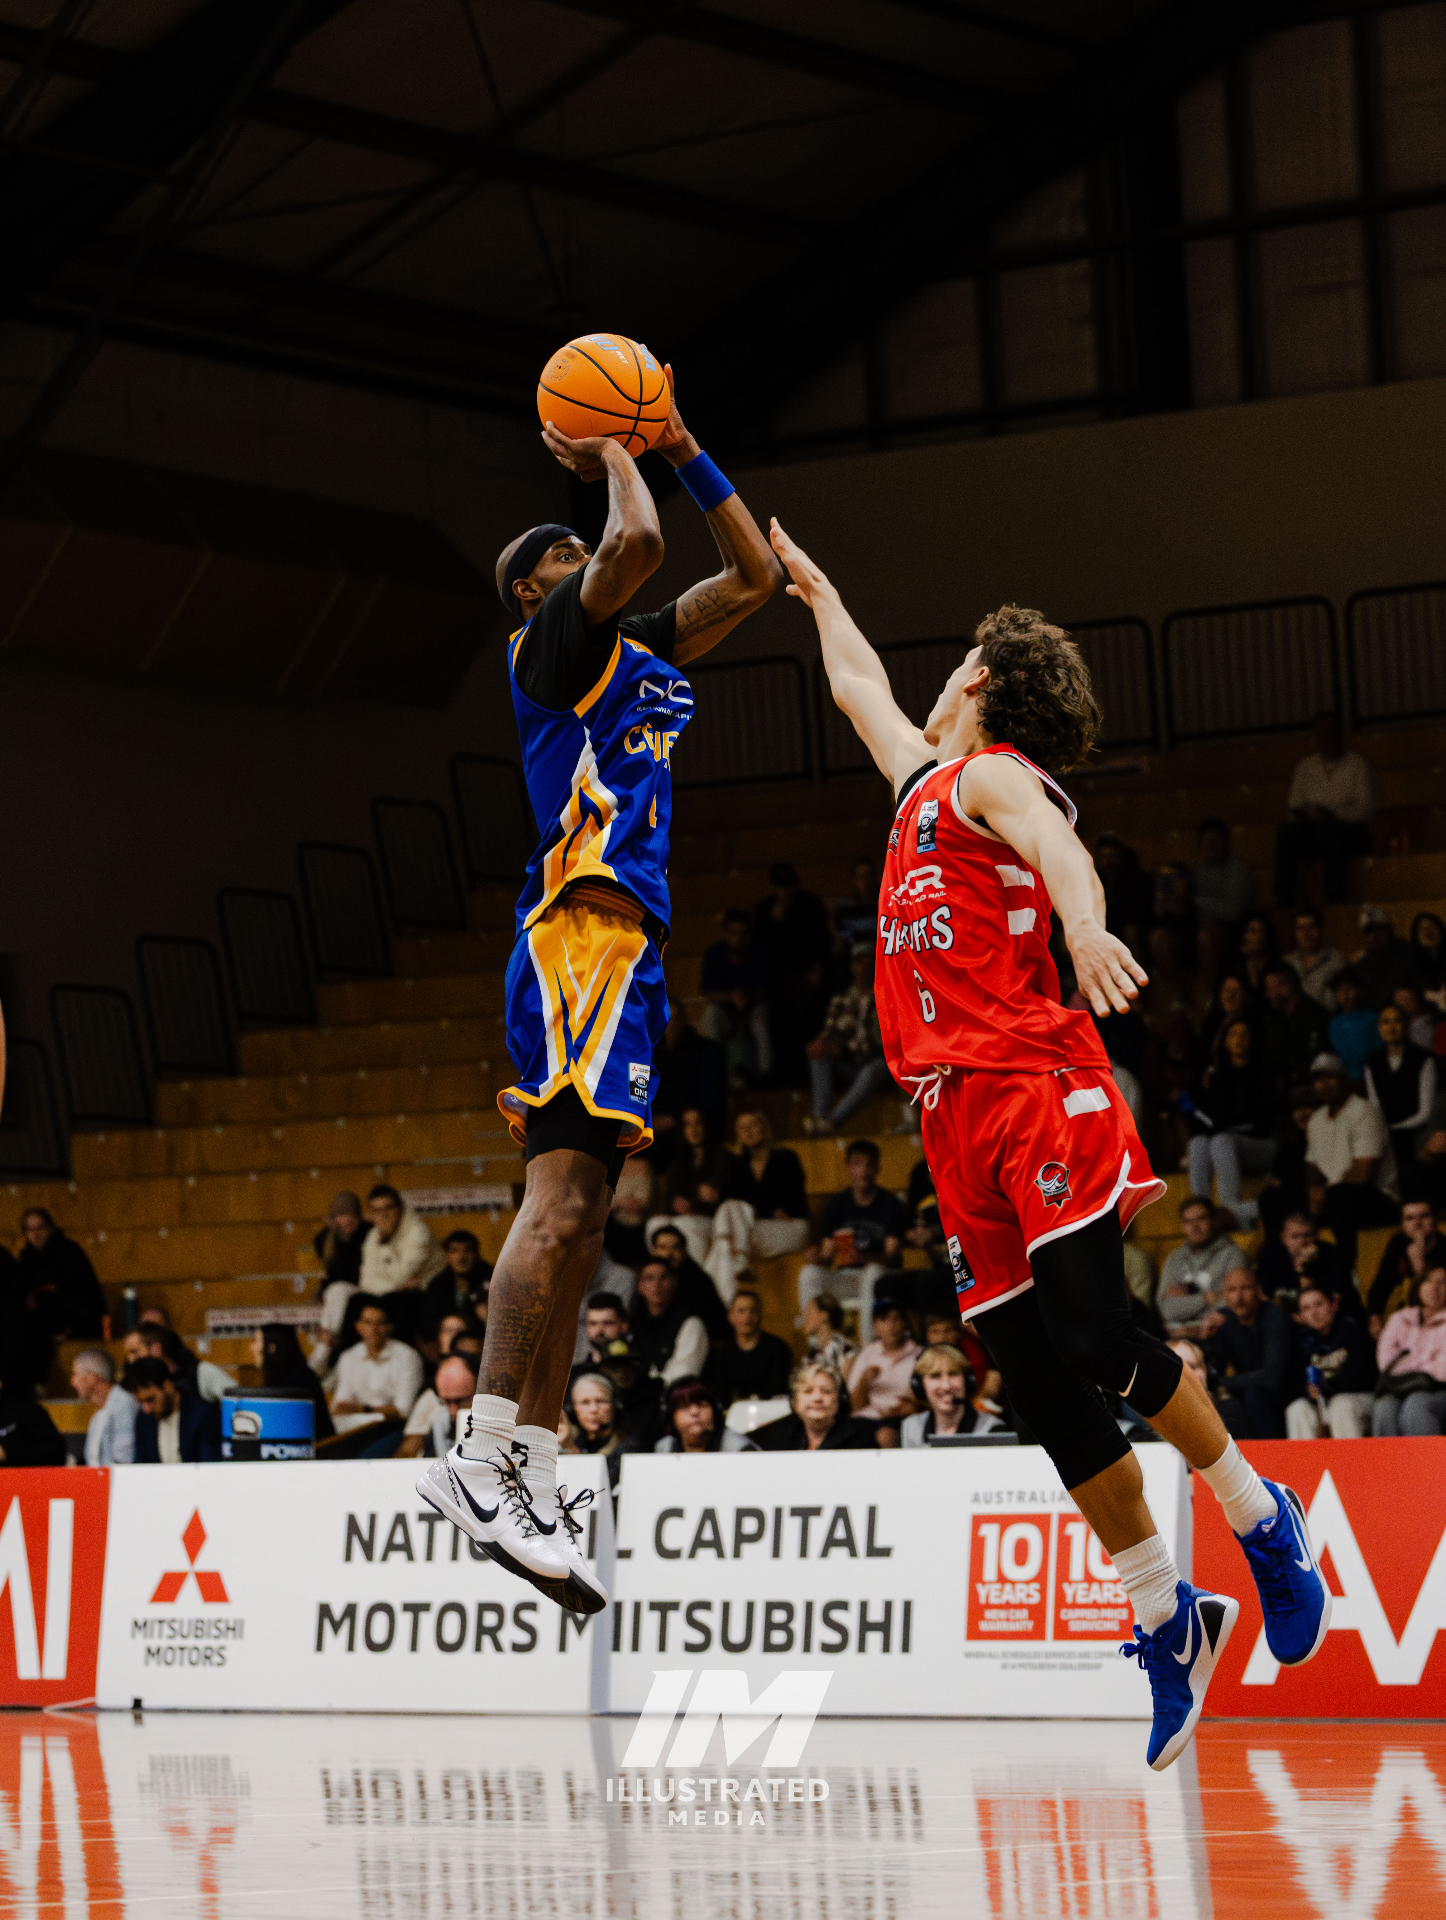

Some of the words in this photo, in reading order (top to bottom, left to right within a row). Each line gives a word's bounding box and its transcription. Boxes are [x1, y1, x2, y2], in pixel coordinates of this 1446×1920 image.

[913, 968, 937, 1024] 6
[634, 1087, 648, 1099] ONE
[654, 1505, 893, 1560] CAPITAL
[977, 1522, 1044, 1582] 10
[975, 1582, 1041, 1604] YEARS
[1062, 1582, 1129, 1604] YEARS
[130, 1618, 244, 1640] MITSUBISHI
[316, 1601, 539, 1653] MOTORS
[144, 1645, 227, 1667] MOTORS
